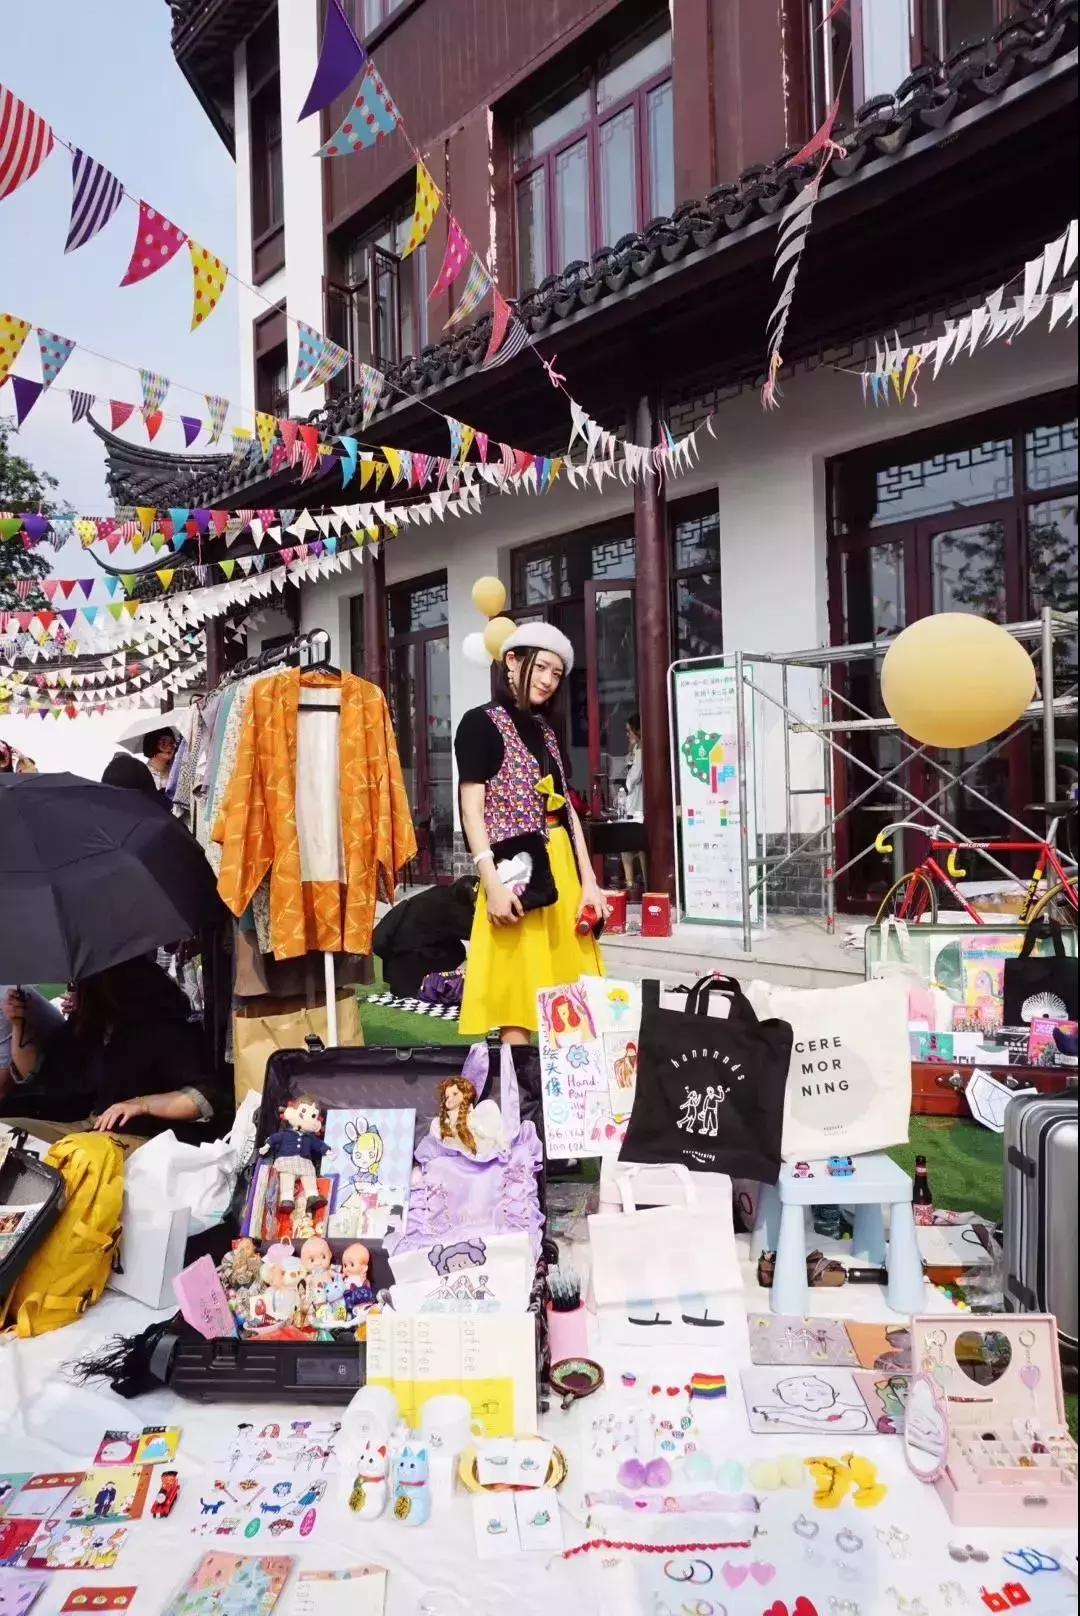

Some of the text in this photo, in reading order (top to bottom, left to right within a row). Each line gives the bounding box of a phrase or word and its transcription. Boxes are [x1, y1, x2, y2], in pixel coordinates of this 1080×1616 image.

[795, 1036, 842, 1053] CERE
[801, 1059, 842, 1075] MOR
[801, 1080, 849, 1097] NING
